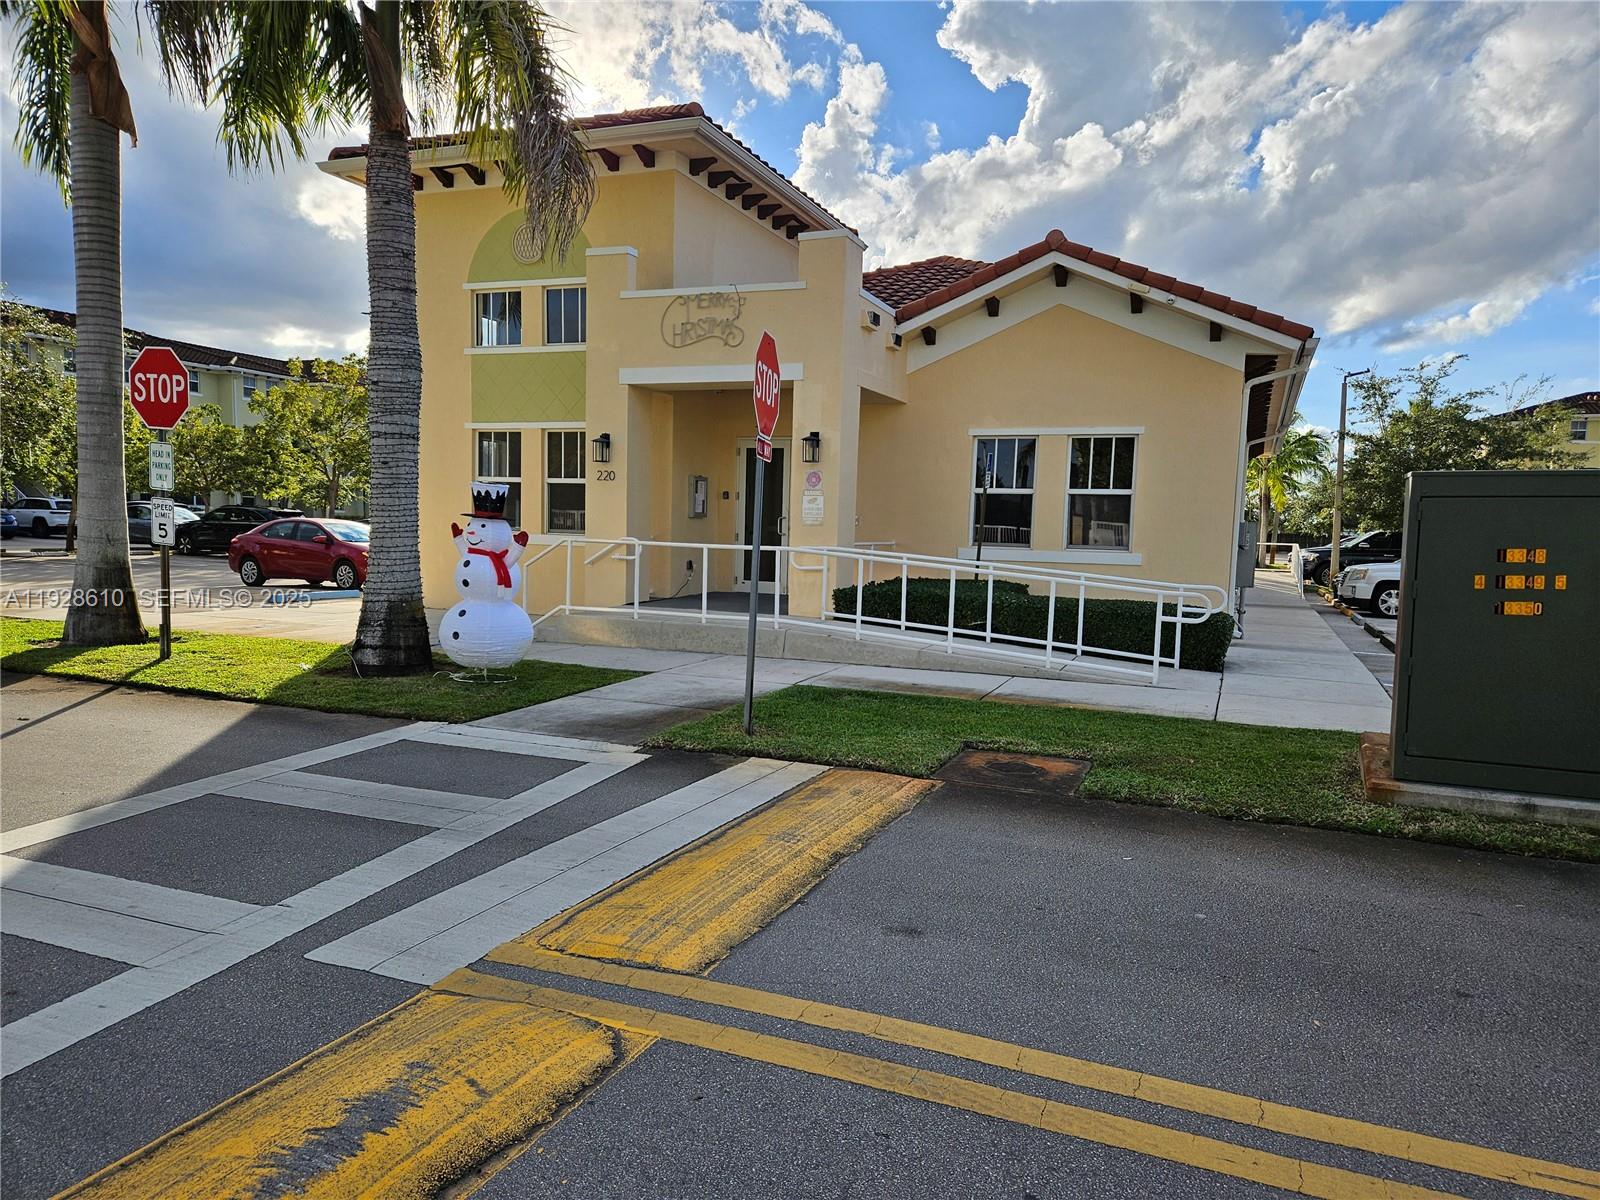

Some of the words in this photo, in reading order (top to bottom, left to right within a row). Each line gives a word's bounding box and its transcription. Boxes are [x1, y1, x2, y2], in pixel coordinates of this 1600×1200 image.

[134, 372, 185, 404] STOP
[756, 360, 779, 408] STOP
[152, 450, 164, 458] HEAD
[165, 450, 171, 458] IN
[152, 461, 171, 470] PARKING
[156, 473, 168, 481] ONLY
[596, 470, 616, 481] 220
[153, 503, 173, 511] SPEED
[155, 511, 171, 519] LIMIT
[158, 522, 168, 539] 5
[1499, 549, 1546, 563] 13348
[1475, 575, 1484, 588] 4
[1498, 575, 1544, 589] 13349
[1556, 575, 1566, 589] 5
[1495, 602, 1542, 615] 13350
